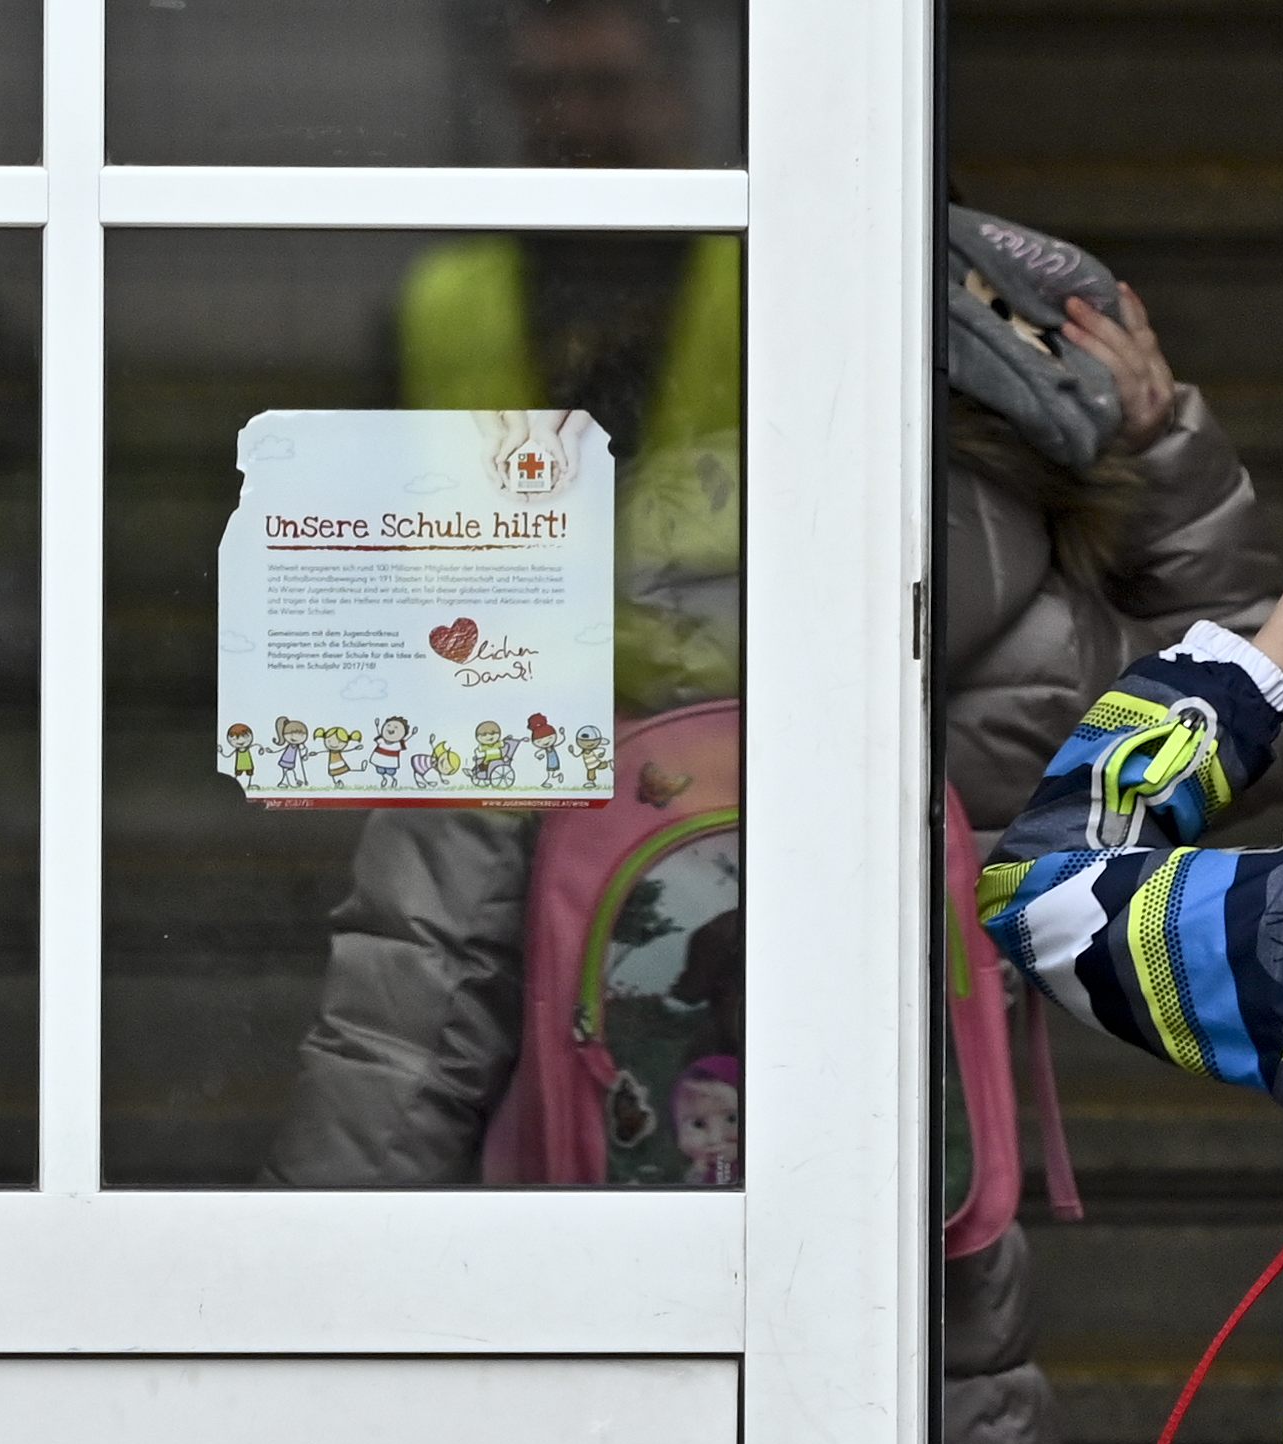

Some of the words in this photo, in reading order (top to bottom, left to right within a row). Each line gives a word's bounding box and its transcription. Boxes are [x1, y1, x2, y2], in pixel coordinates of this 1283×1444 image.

[381, 512, 482, 539] Schule
[493, 510, 567, 538] hilft!
[454, 661, 533, 687] Dank!
